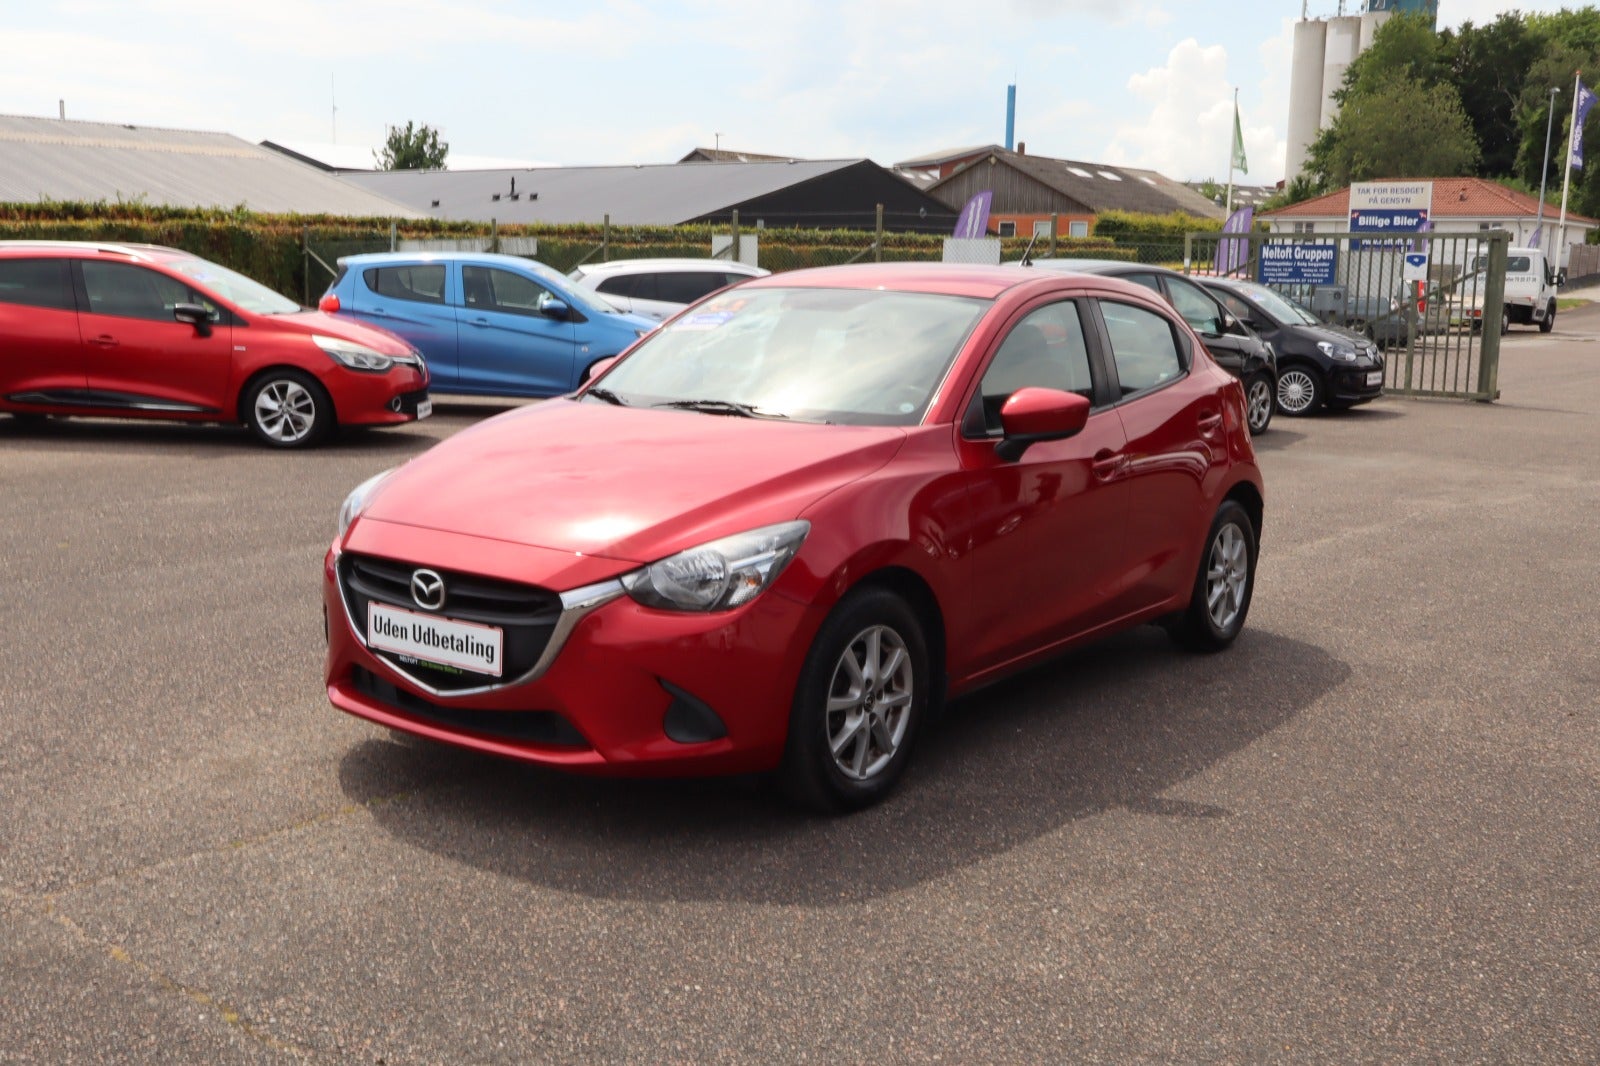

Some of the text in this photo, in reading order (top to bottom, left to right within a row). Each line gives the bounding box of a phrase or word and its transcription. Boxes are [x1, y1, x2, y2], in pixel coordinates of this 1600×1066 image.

[1368, 196, 1379, 204] PÅ
[1358, 215, 1419, 228] Billige Biler
[1262, 246, 1334, 262] Neltoft Gruppen
[374, 614, 495, 664] Uden Udbetaling
